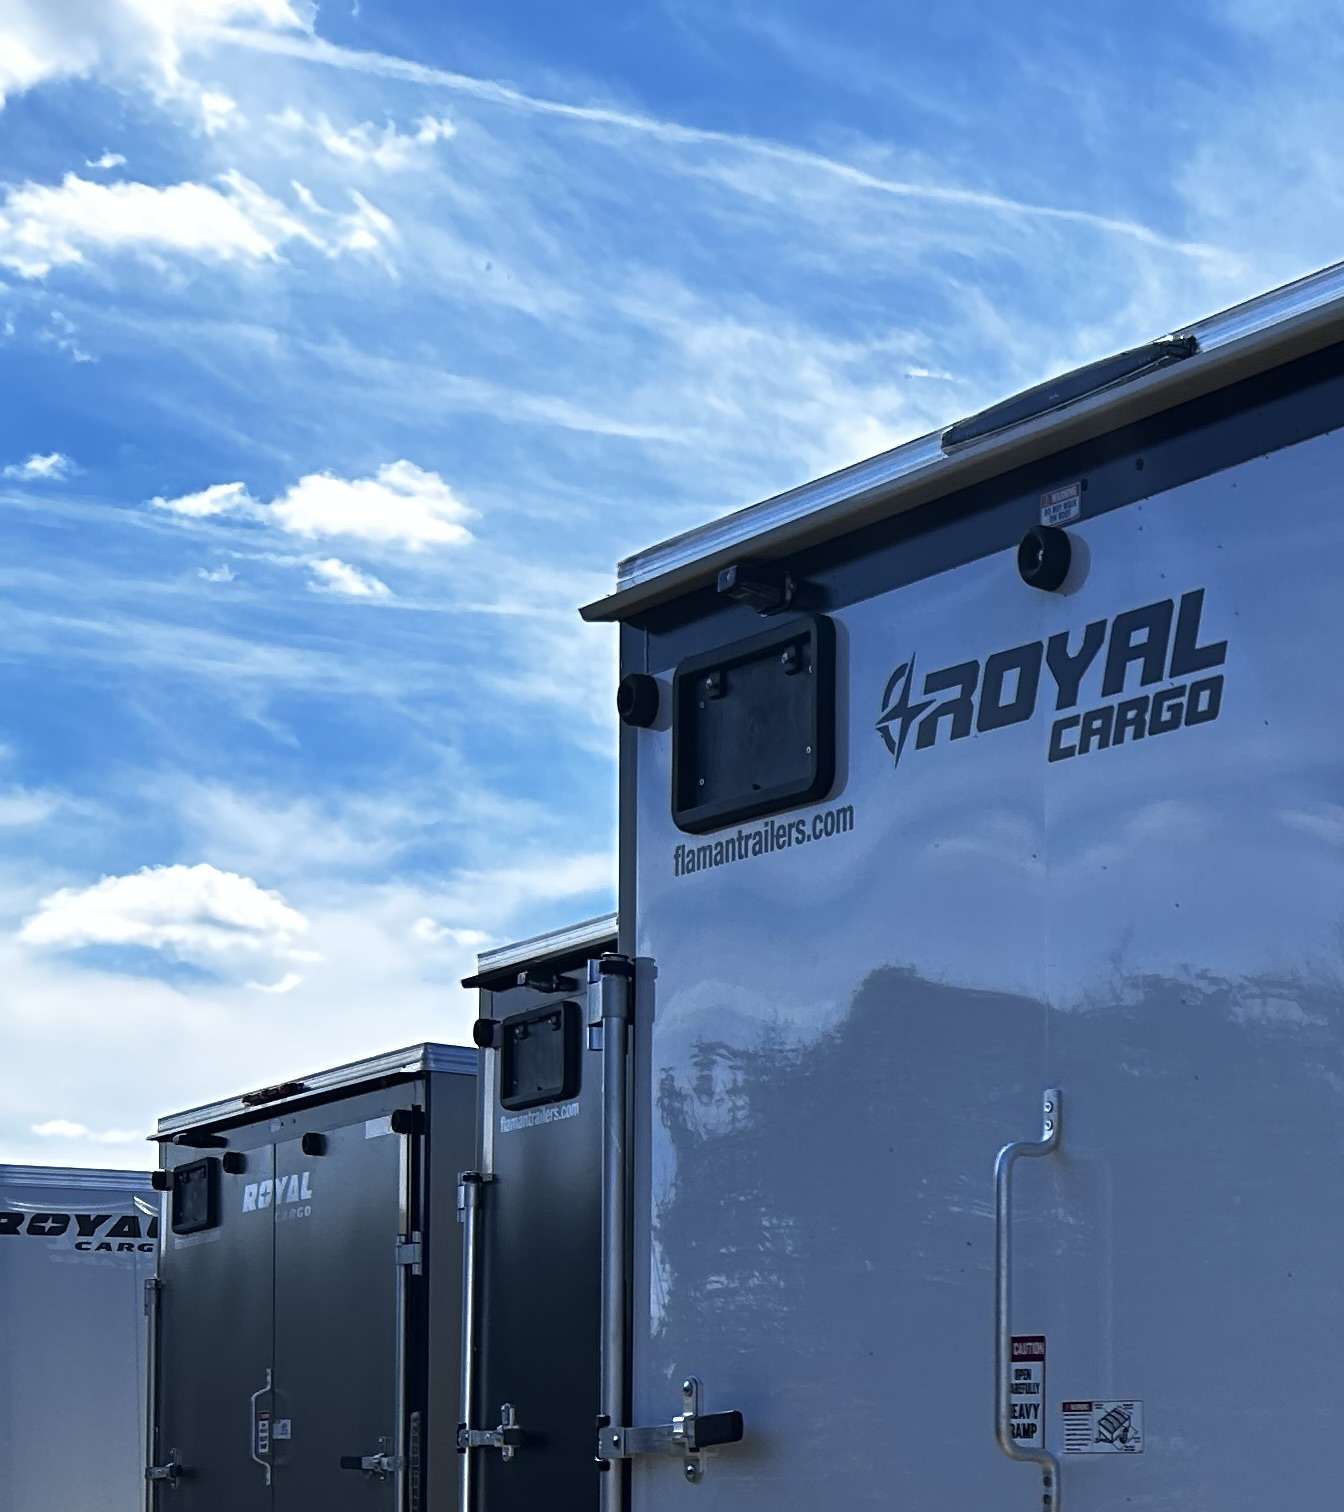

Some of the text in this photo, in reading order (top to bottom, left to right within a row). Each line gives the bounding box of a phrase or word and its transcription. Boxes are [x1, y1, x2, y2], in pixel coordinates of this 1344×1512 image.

[915, 588, 1228, 750] ROYAL
[1048, 674, 1224, 763] CARGO
[673, 804, 855, 877] flamantrailers.com
[242, 1171, 313, 1213] ROYAL
[1010, 1382, 1041, 1395] AREFULLY
[1010, 1403, 1041, 1420] EAVY
